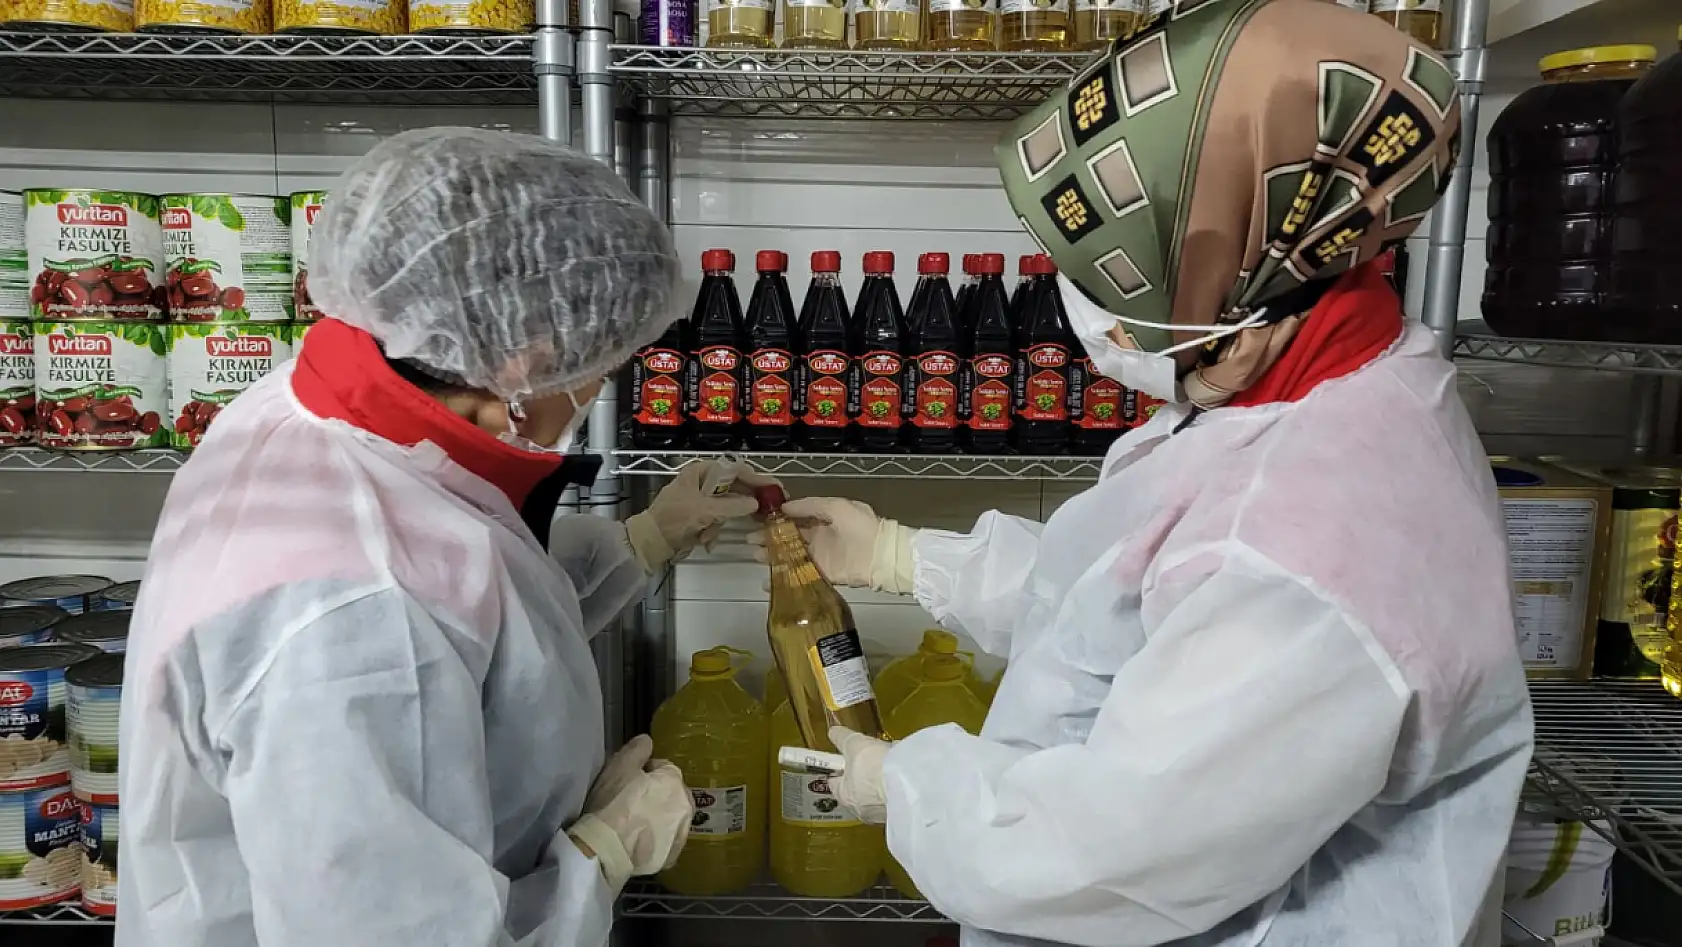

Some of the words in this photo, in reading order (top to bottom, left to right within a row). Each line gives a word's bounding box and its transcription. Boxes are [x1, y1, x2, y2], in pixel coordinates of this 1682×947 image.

[62, 207, 123, 224] yurttan
[60, 227, 127, 240] KIRMIZI
[58, 240, 131, 253] FASULYE
[52, 337, 108, 352] yurttan
[210, 338, 269, 355] yurttan
[50, 357, 111, 369] KIRMIZI
[209, 358, 272, 370] KIRMIZI
[49, 369, 116, 381] FASULYE
